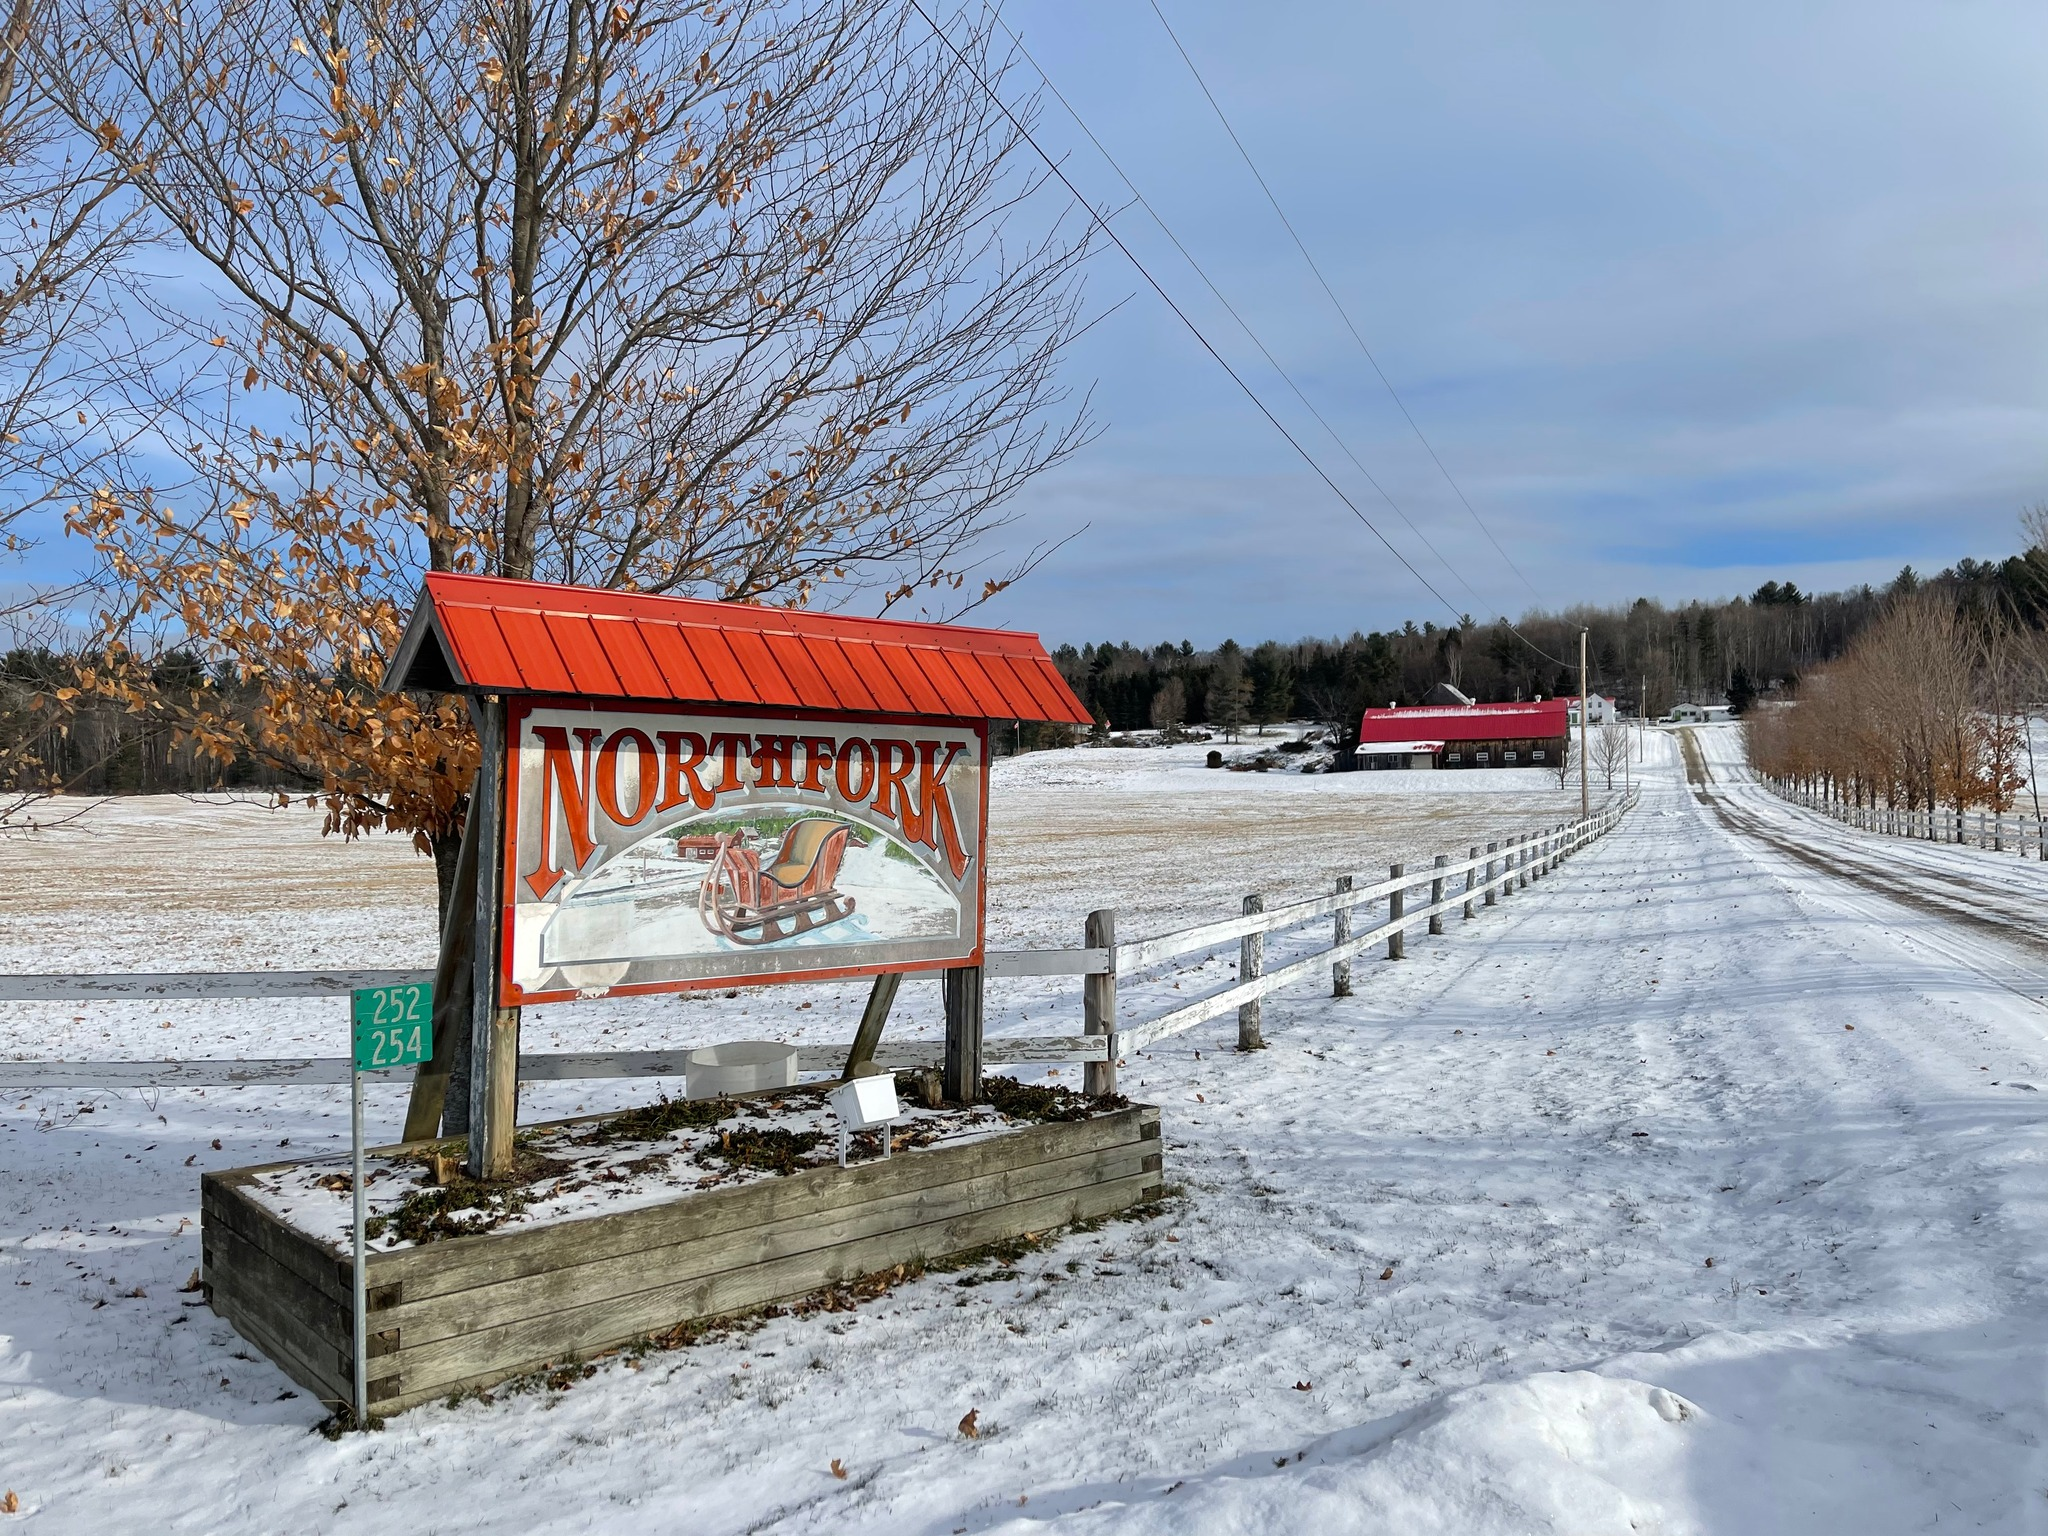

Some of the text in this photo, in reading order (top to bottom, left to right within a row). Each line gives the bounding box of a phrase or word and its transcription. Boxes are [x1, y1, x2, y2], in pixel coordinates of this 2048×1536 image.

[524, 726, 972, 900] NORTHFORK
[372, 986, 420, 1025] 252
[371, 1026, 422, 1065] 254
